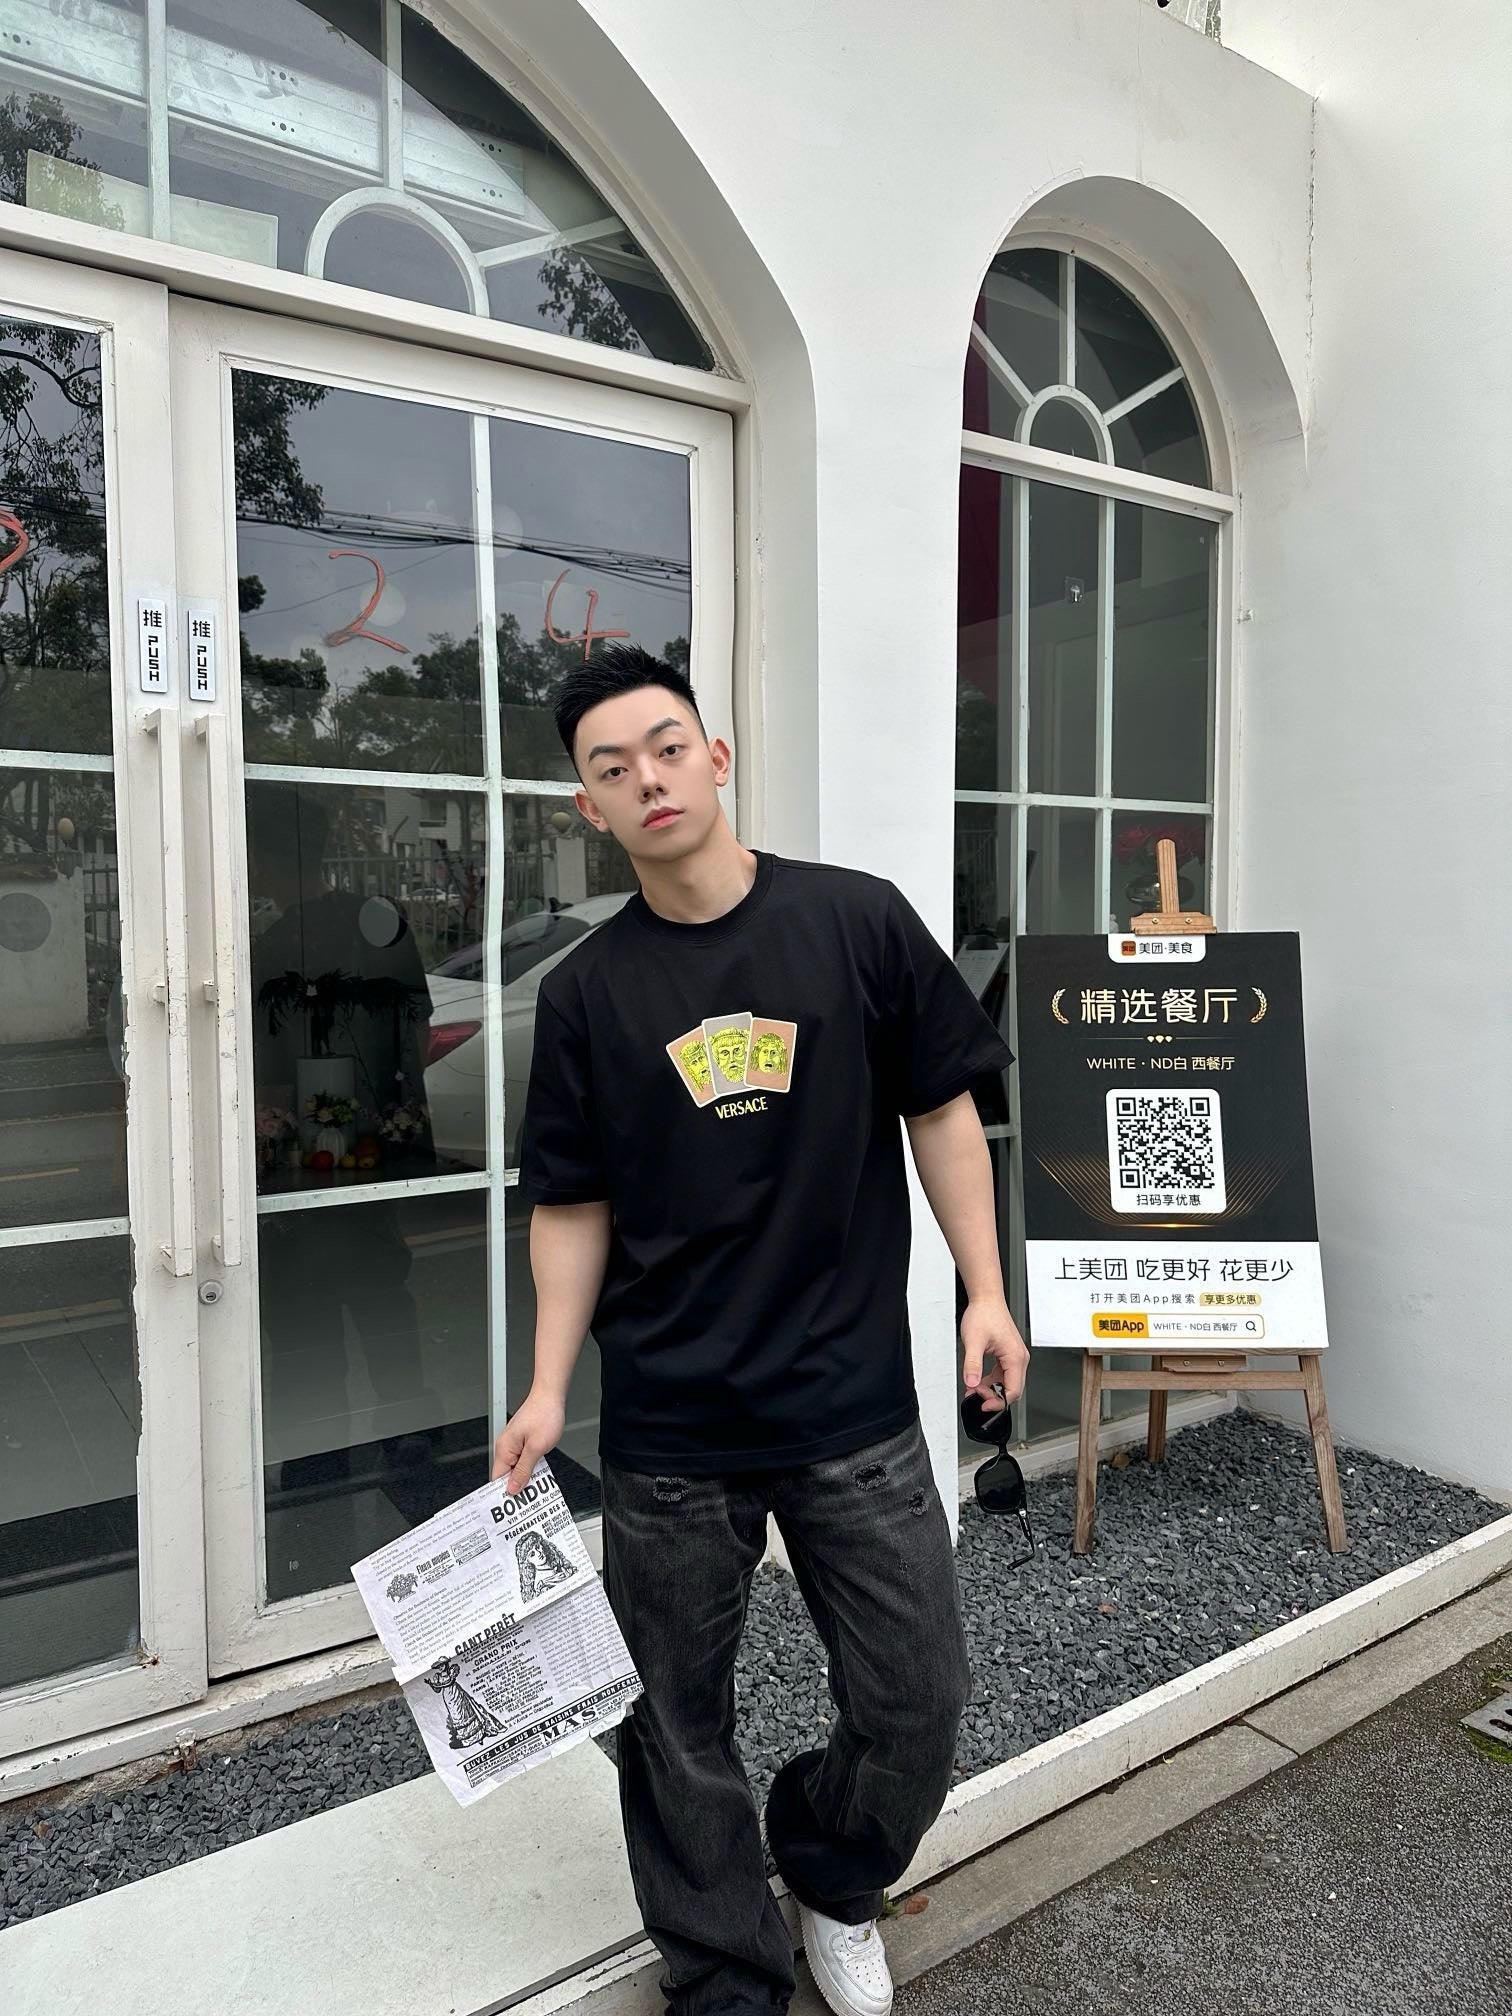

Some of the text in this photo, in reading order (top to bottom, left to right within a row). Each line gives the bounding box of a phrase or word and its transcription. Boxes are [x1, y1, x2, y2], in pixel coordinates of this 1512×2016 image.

[143, 609, 162, 628] 推
[324, 550, 631, 663] 2 4
[192, 620, 211, 638] 推
[148, 635, 160, 682] PUSH
[197, 645, 208, 690] PUSH
[1080, 988, 1238, 1024] 精选餐厅
[1086, 1057, 1136, 1069] WHITE
[1151, 1056, 1187, 1070] ND白
[1192, 1056, 1235, 1070] 西餐厅
[715, 1096, 768, 1120] VERSACE
[1136, 1194, 1201, 1206] 扫码享优惠
[1054, 1258, 1294, 1282] 上美团 吃更好 花更少
[1090, 1293, 1257, 1305] 打开美团App搜索 享更多优惠
[1098, 1319, 1144, 1332] 美团App
[1153, 1323, 1182, 1331] WHITE
[1213, 1322, 1238, 1331] 西餐厅
[474, 1649, 498, 1666] GRAND
[500, 1638, 517, 1651] PRIX
[464, 1752, 490, 1770] BUVEZ
[494, 1742, 509, 1754] LES
[512, 1732, 528, 1743] JUS
[532, 1723, 542, 1733] DE
[543, 1708, 573, 1727] RAISINS
[575, 1696, 598, 1710] FRAIS
[541, 1707, 595, 1741] MAS
